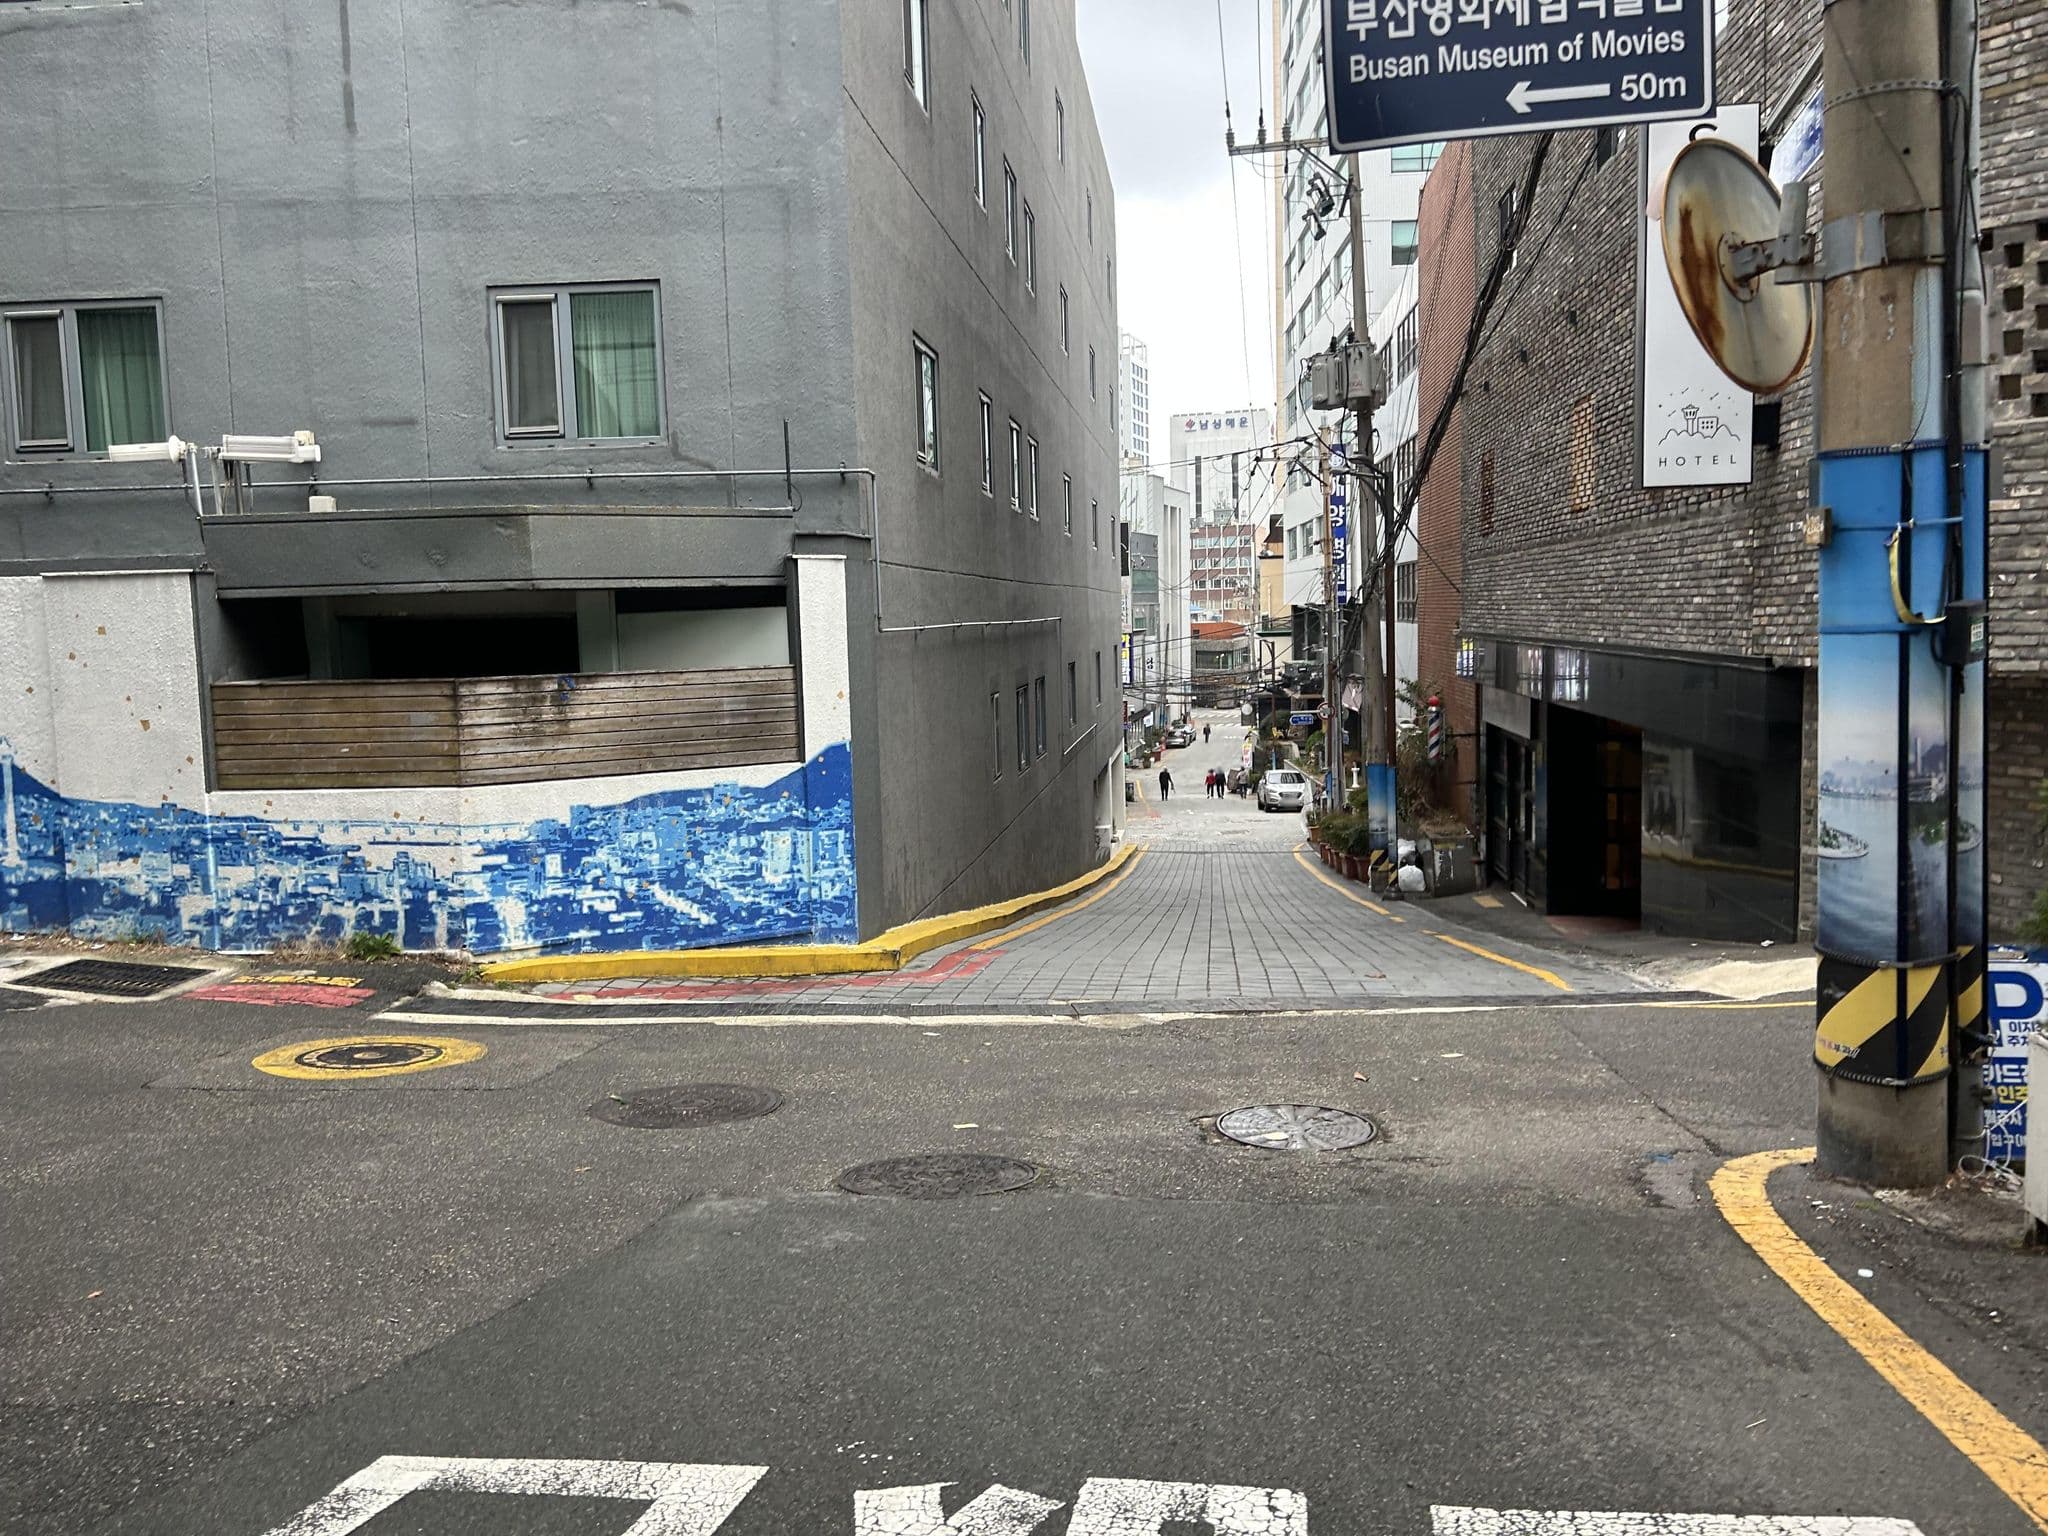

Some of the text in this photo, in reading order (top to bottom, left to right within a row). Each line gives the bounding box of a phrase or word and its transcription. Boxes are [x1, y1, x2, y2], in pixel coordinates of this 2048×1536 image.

[1350, 26, 1686, 83] Busan Museum of Movies
[1620, 73, 1686, 102] 50m
[1658, 454, 1737, 467] HOTEL
